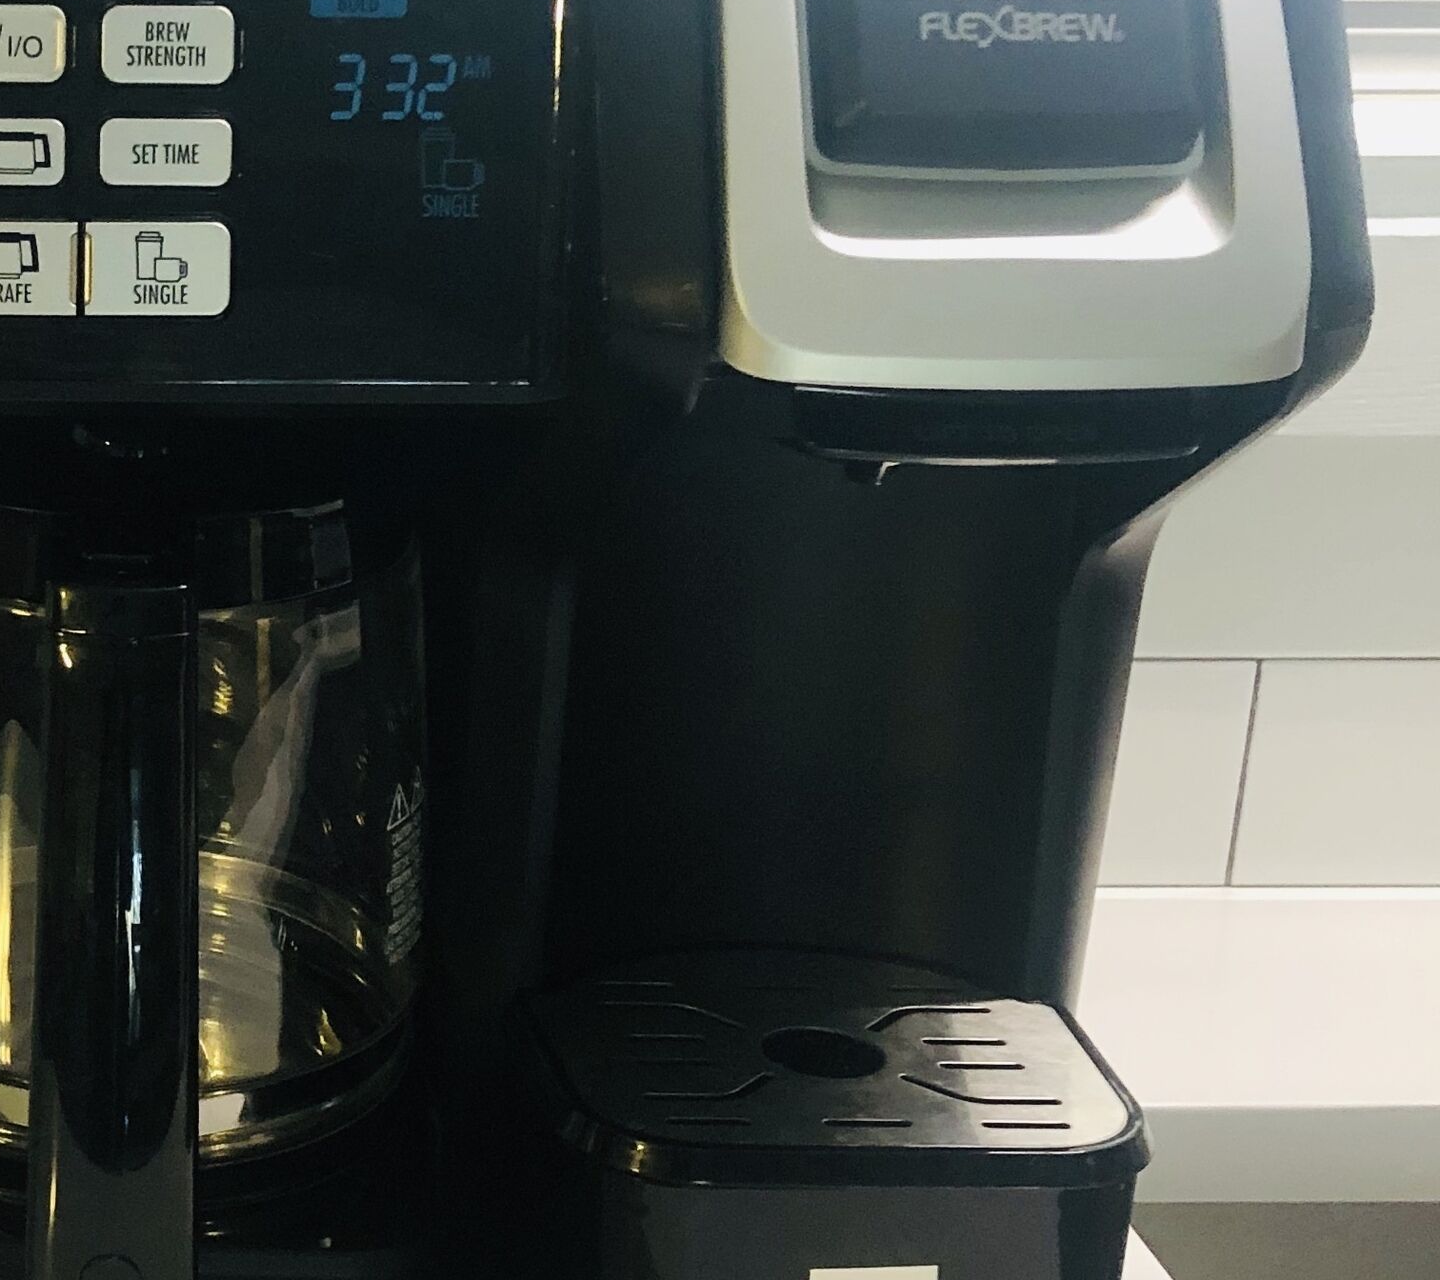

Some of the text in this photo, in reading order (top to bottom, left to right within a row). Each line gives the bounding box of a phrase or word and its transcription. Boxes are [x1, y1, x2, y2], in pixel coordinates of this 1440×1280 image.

[145, 21, 190, 42] BREW
[126, 45, 206, 67] STRENGTH
[463, 55, 493, 80] AM
[132, 143, 200, 165] SET TIME
[422, 193, 480, 218] SINGLE
[133, 284, 188, 305] SINGLE
